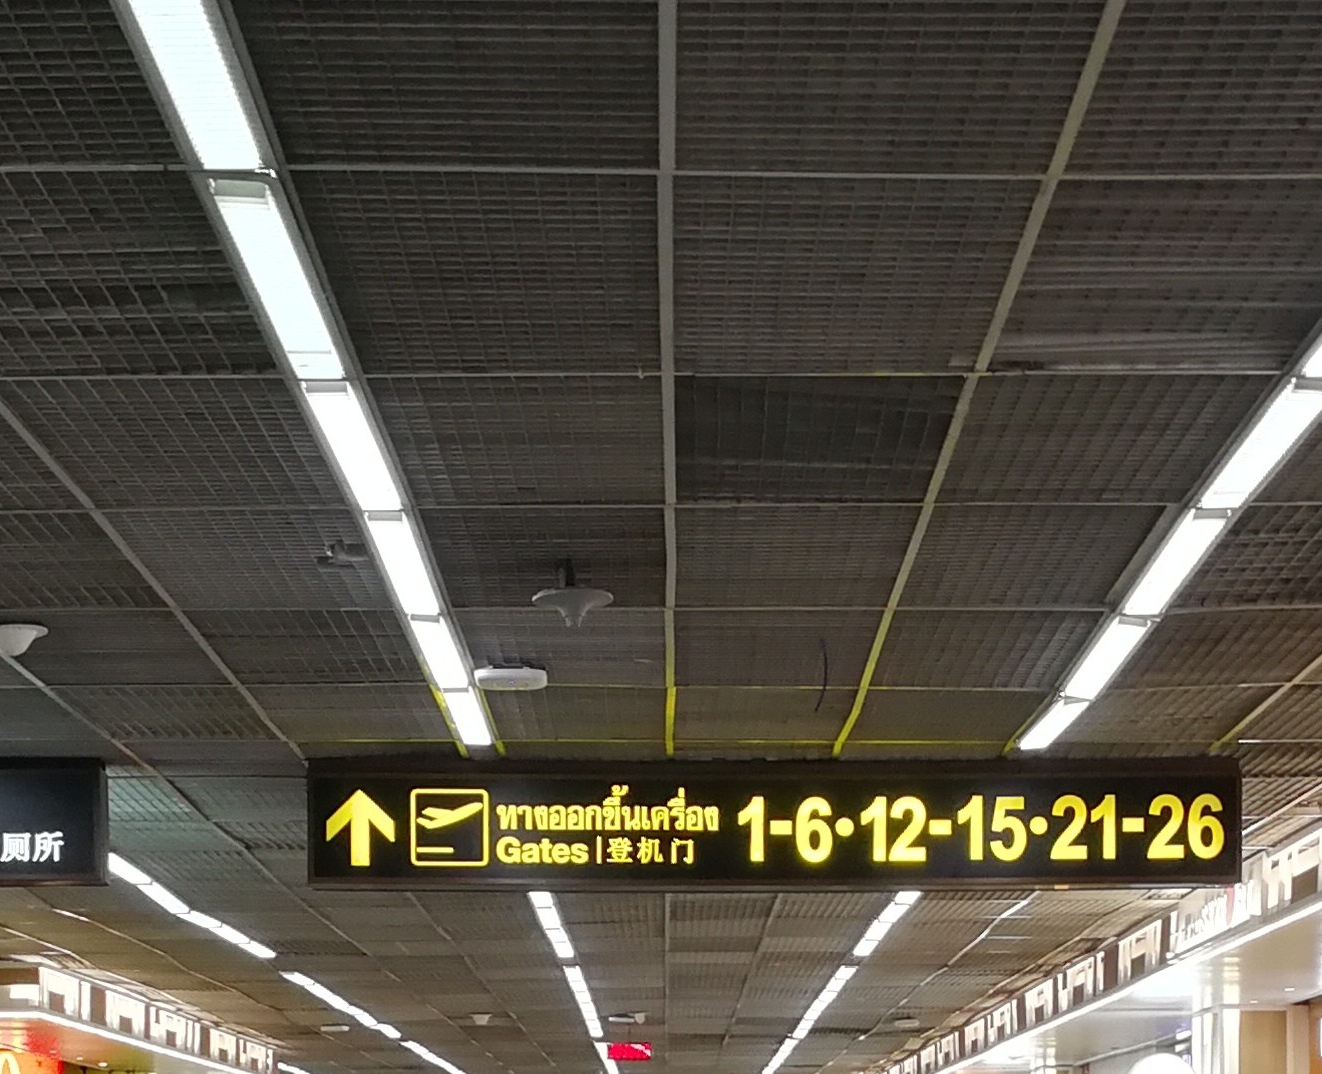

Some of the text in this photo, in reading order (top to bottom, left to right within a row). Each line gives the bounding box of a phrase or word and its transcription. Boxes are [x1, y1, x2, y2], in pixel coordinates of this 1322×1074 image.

[496, 784, 720, 831] ทางออกขึ้นเครื่อง
[0, 831, 65, 863] 厕所
[496, 835, 590, 864] Gates
[606, 836, 695, 864] 登机门
